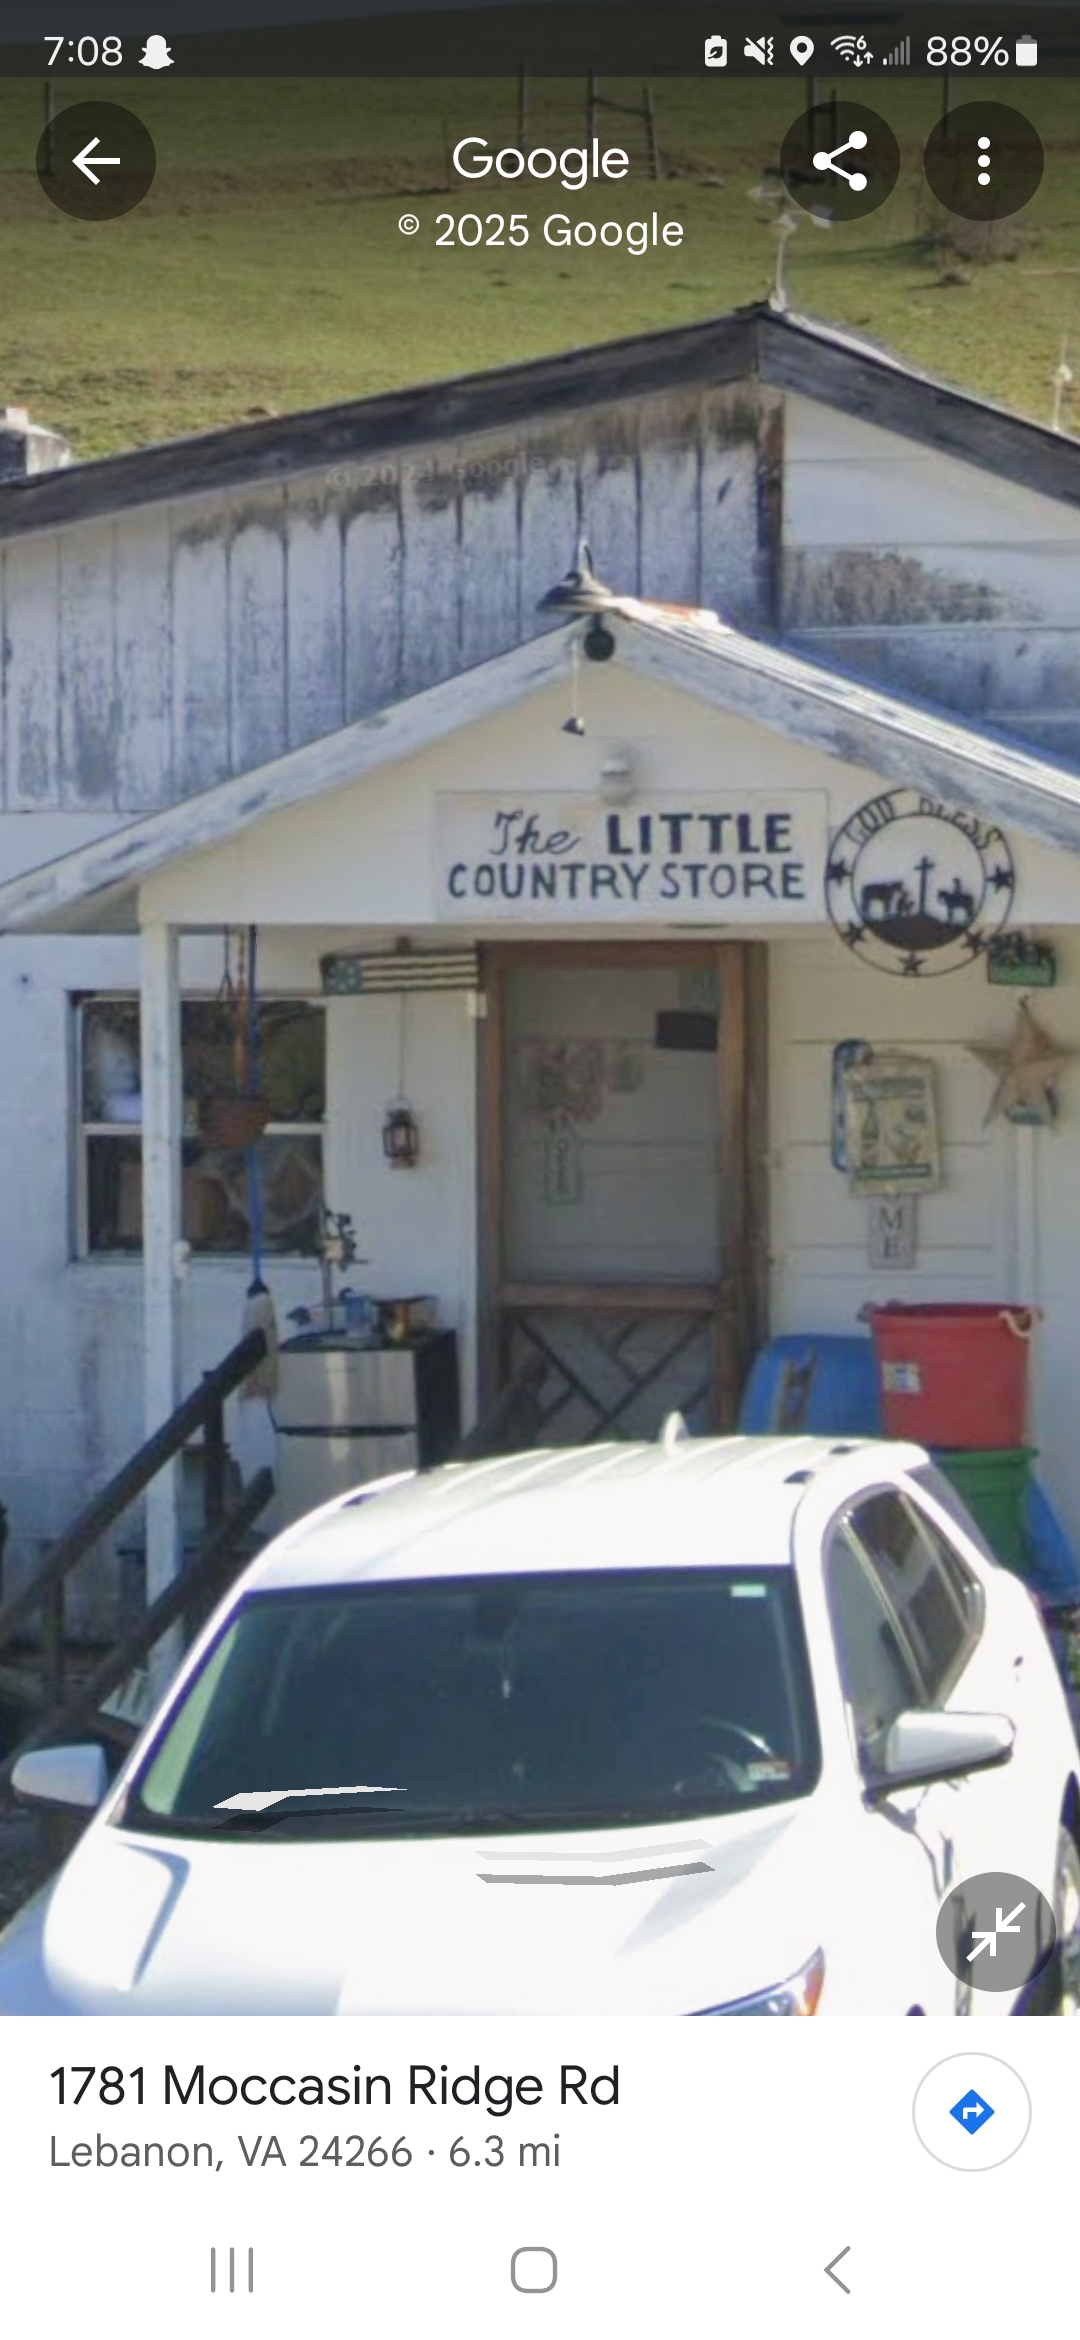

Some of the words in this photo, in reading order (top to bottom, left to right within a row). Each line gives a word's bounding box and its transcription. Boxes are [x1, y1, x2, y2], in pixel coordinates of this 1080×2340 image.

[489, 810, 585, 857] The
[606, 812, 793, 856] LITTLE
[447, 861, 650, 901] COUNTRY
[660, 861, 806, 901] STORE
